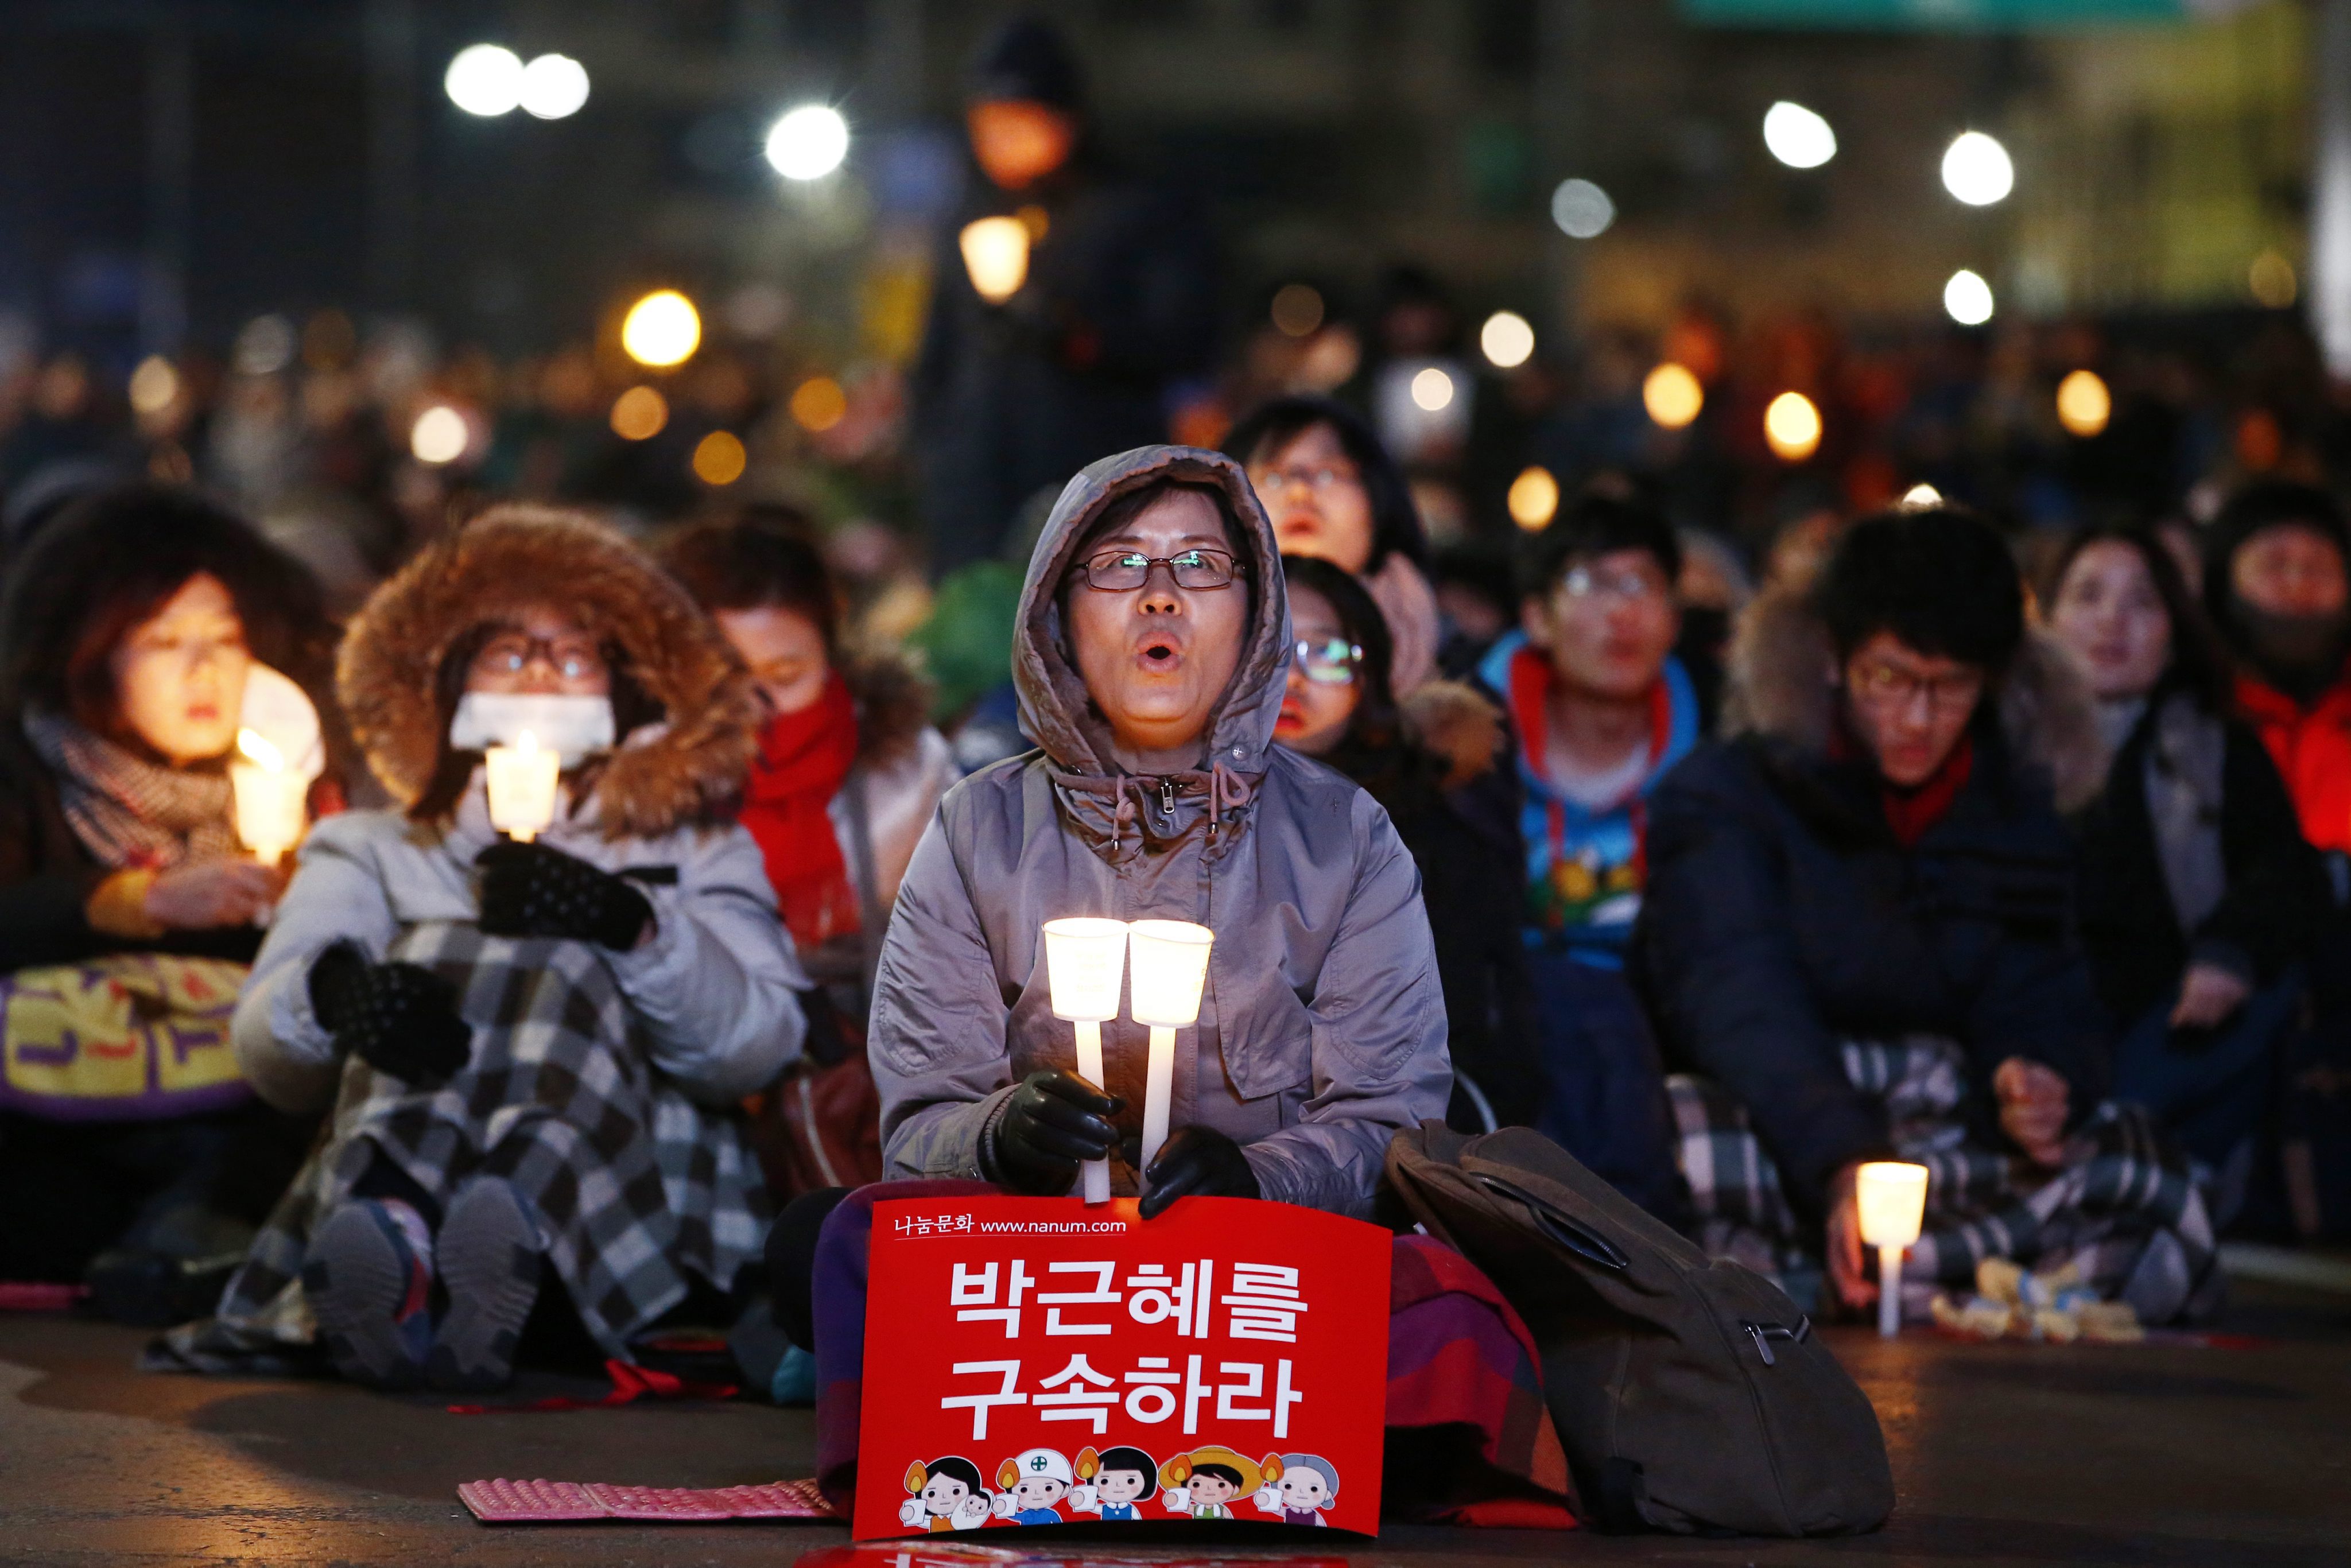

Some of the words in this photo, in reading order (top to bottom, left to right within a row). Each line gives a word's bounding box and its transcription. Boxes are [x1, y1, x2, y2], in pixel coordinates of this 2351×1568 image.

[894, 1213, 975, 1236] 나눔문화
[980, 1221, 1127, 1233] www.nanum.com
[950, 1259, 1308, 1343] 박근혜를
[941, 1353, 1303, 1441] 구속하라
